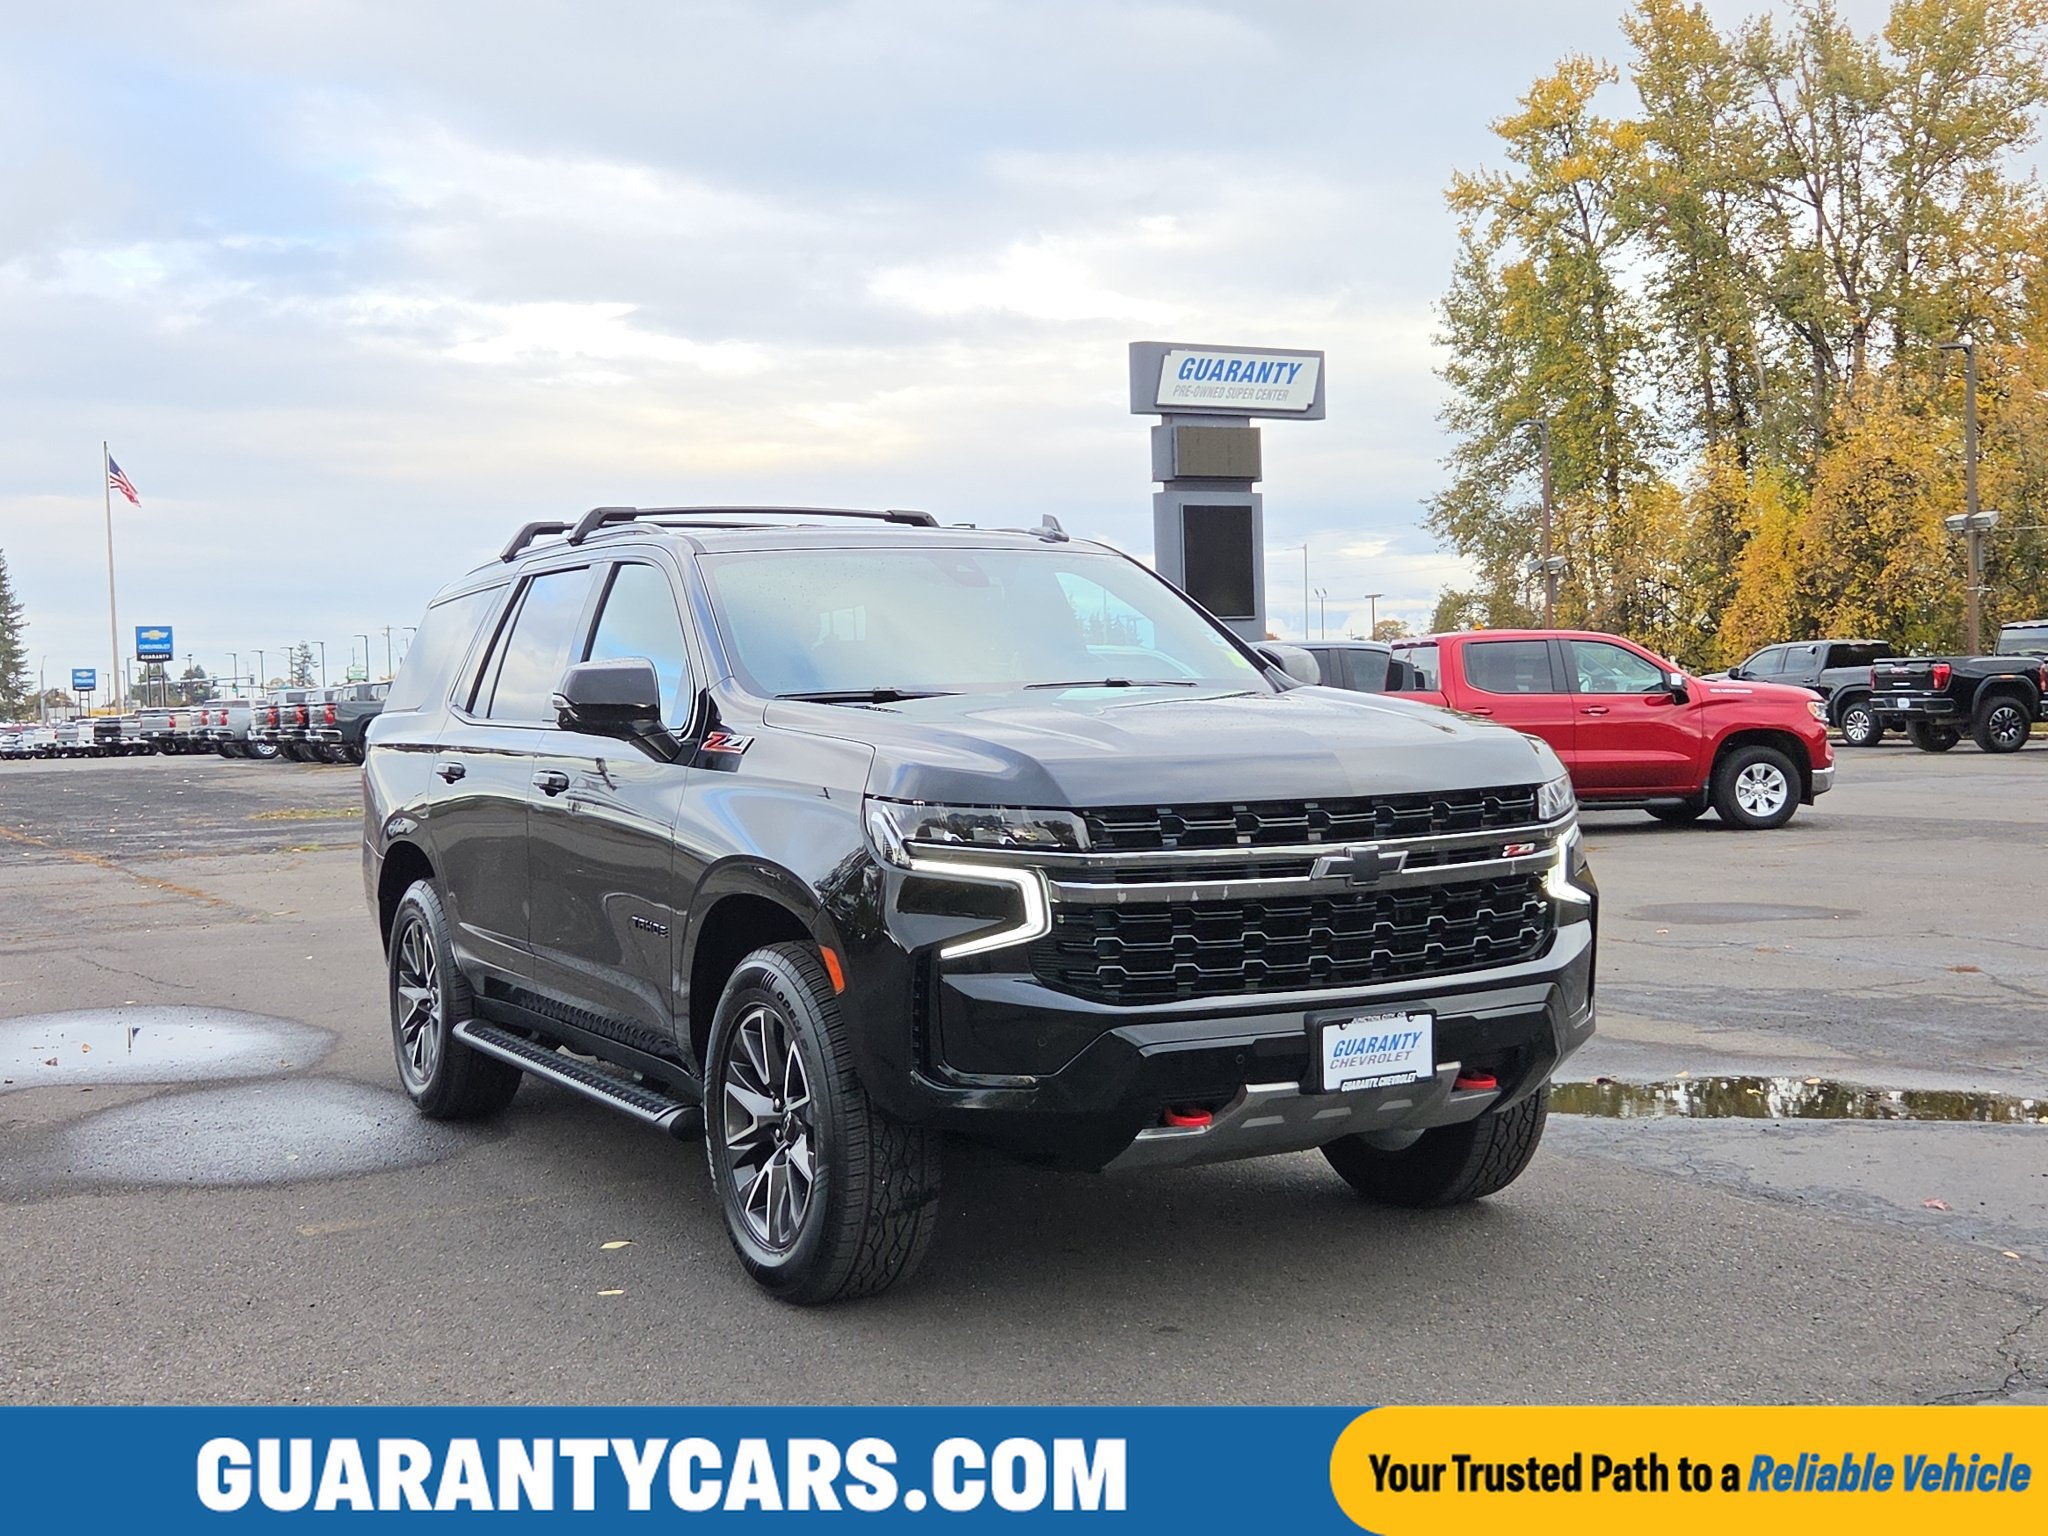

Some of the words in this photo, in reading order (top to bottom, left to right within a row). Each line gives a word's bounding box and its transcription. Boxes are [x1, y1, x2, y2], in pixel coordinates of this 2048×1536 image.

[1178, 357, 1303, 385] GUARANTY
[1172, 384, 1226, 399] PRE-OWNED
[1226, 386, 1254, 400] SUPER
[1255, 388, 1289, 401] CENTER
[631, 914, 669, 939] TAHOE
[1333, 1031, 1423, 1058] GUARANTY
[1330, 1051, 1413, 1070] CHEVROLET
